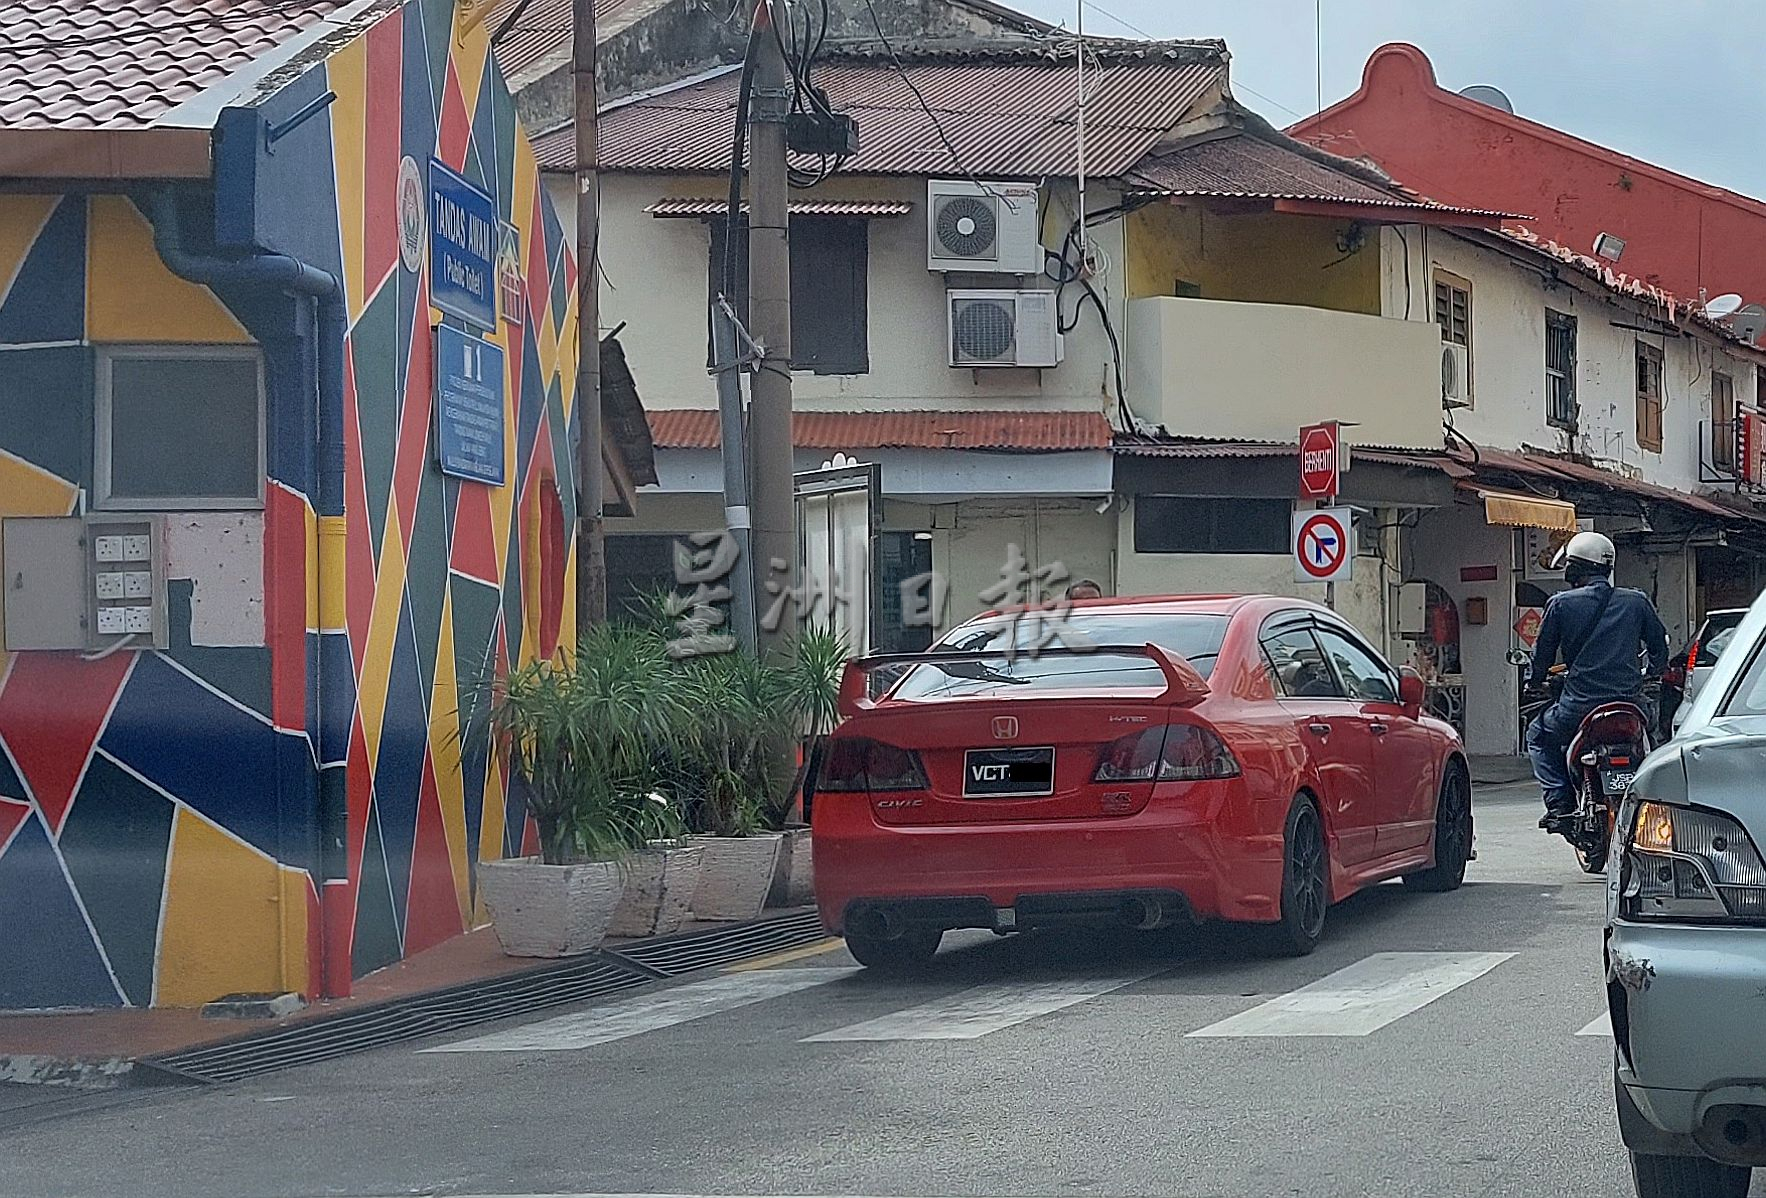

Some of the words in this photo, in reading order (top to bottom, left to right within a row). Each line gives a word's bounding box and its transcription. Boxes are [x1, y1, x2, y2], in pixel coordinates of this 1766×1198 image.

[434, 191, 466, 249] TANDAS
[468, 211, 490, 263] AWAM
[443, 251, 465, 288] (Public
[1304, 448, 1332, 475] BERHENTI
